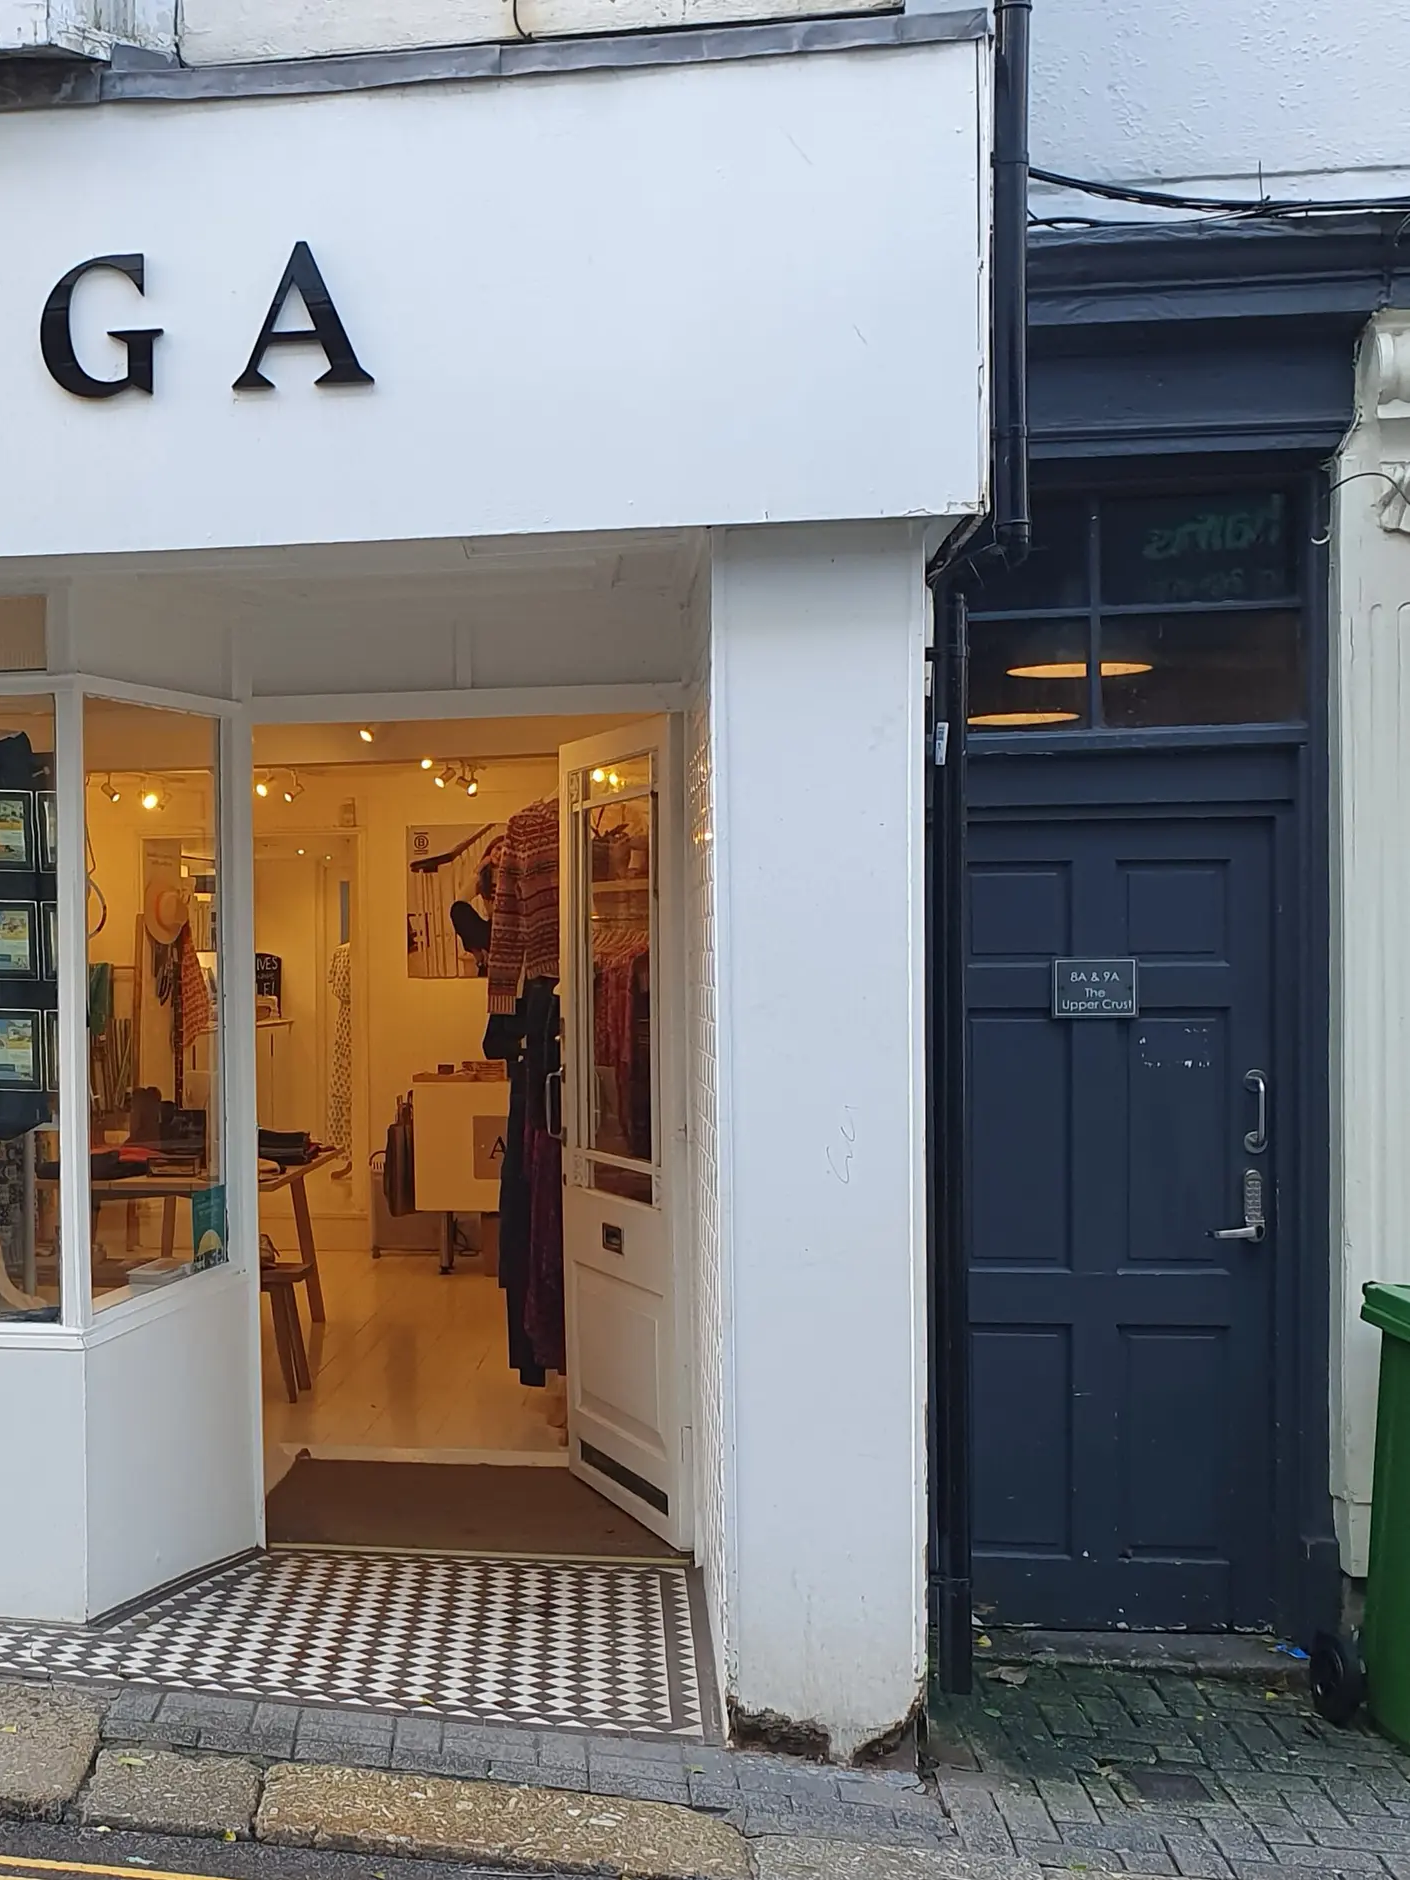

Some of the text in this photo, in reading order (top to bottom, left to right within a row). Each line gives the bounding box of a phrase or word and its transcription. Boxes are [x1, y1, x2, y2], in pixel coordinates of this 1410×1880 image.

[1070, 971, 1120, 982] 8A & 9A
[1084, 987, 1106, 998] The
[1062, 999, 1132, 1012] Upper Crust
